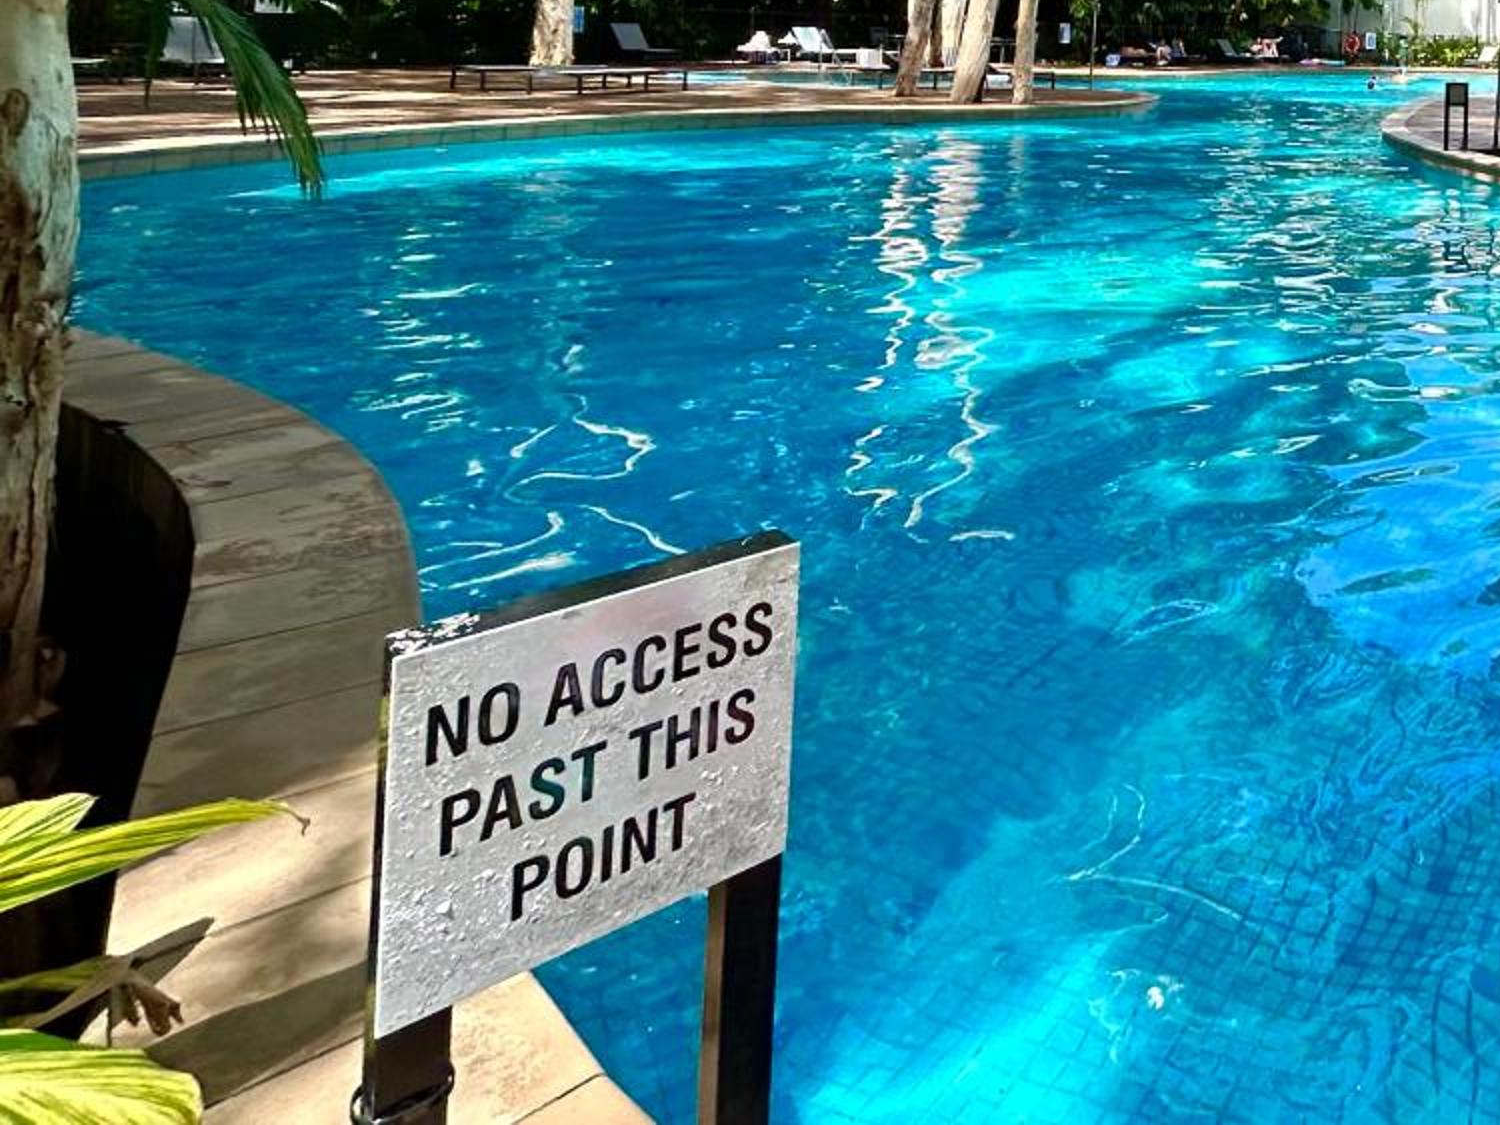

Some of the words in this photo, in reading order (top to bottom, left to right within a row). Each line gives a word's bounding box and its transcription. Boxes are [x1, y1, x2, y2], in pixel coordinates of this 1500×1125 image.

[424, 681, 521, 766] NO
[543, 601, 774, 727] ACCESS
[438, 741, 607, 857] PAST
[628, 687, 757, 780] THIS
[510, 792, 697, 922] POINT
